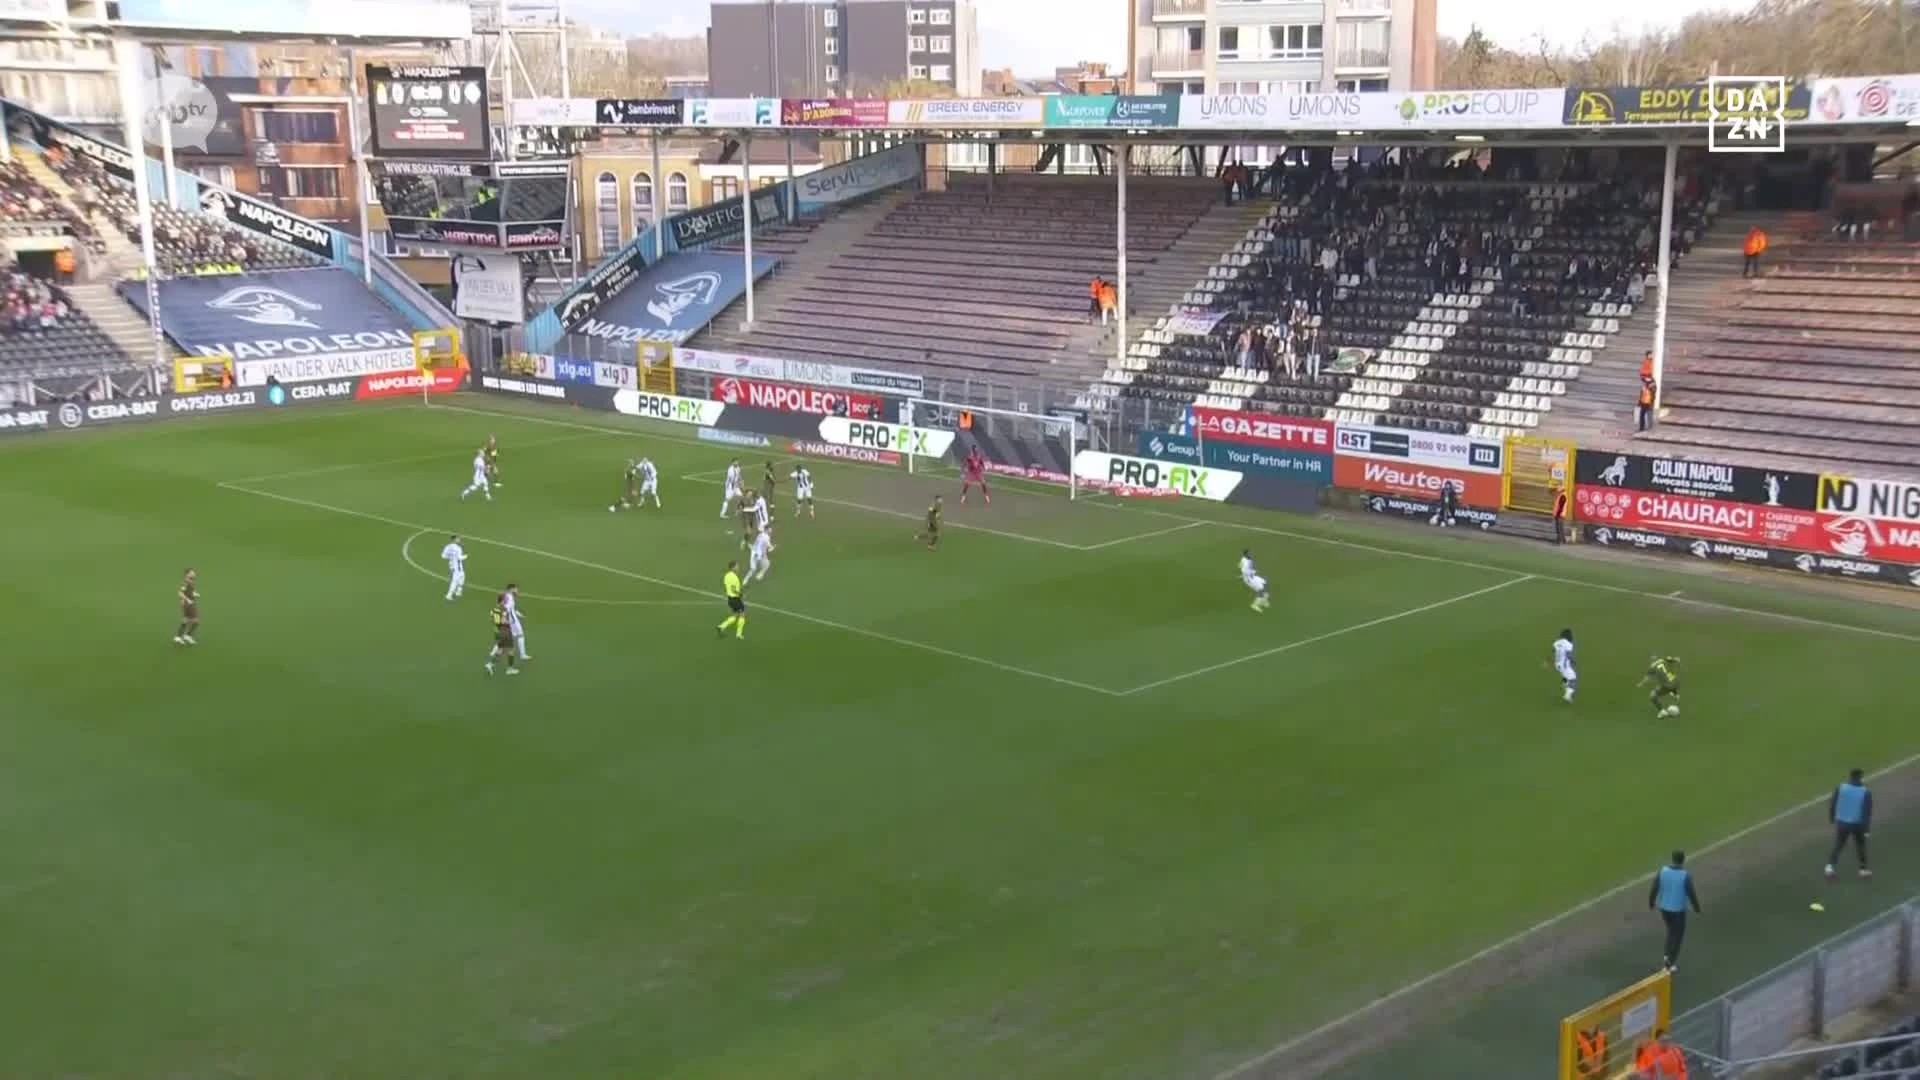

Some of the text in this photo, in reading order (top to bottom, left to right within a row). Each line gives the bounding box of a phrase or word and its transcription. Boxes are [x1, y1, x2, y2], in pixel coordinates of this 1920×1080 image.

[928, 101, 1023, 112] GREEN ENERGY
[1201, 96, 1267, 117] UMONS
[1289, 95, 1360, 117] UMONS
[1640, 89, 1695, 108] EDDY
[627, 102, 677, 116] Sambrinvest
[239, 199, 329, 246] NAPOLEON
[195, 329, 414, 359] NAPOLEON
[263, 350, 414, 378] VAN DER VALK HOTELS
[292, 382, 352, 400] CERA-BAT
[368, 375, 435, 392] NAPOLEON
[88, 401, 159, 419] CERA-BAT
[1221, 417, 1328, 445] GAZETTE
[1341, 432, 1367, 448] RST
[806, 443, 879, 461] NAPOLEON
[1167, 443, 1195, 457] Group
[1411, 439, 1433, 450] 0800
[1228, 450, 1322, 472] Your Partner in HR
[1652, 459, 1733, 483] COLIN NAPOLI
[1651, 475, 1691, 488] Avocats
[1822, 477, 1858, 513] ND
[1388, 499, 1429, 513] NAPOLEON
[1454, 509, 1497, 521] NAPOLEON
[1636, 497, 1753, 528] CHAURACI
[1616, 530, 1666, 546] NAPOLEON
[1714, 543, 1769, 560] NAPOLEON
[1820, 558, 1880, 574] NAPOLEON
